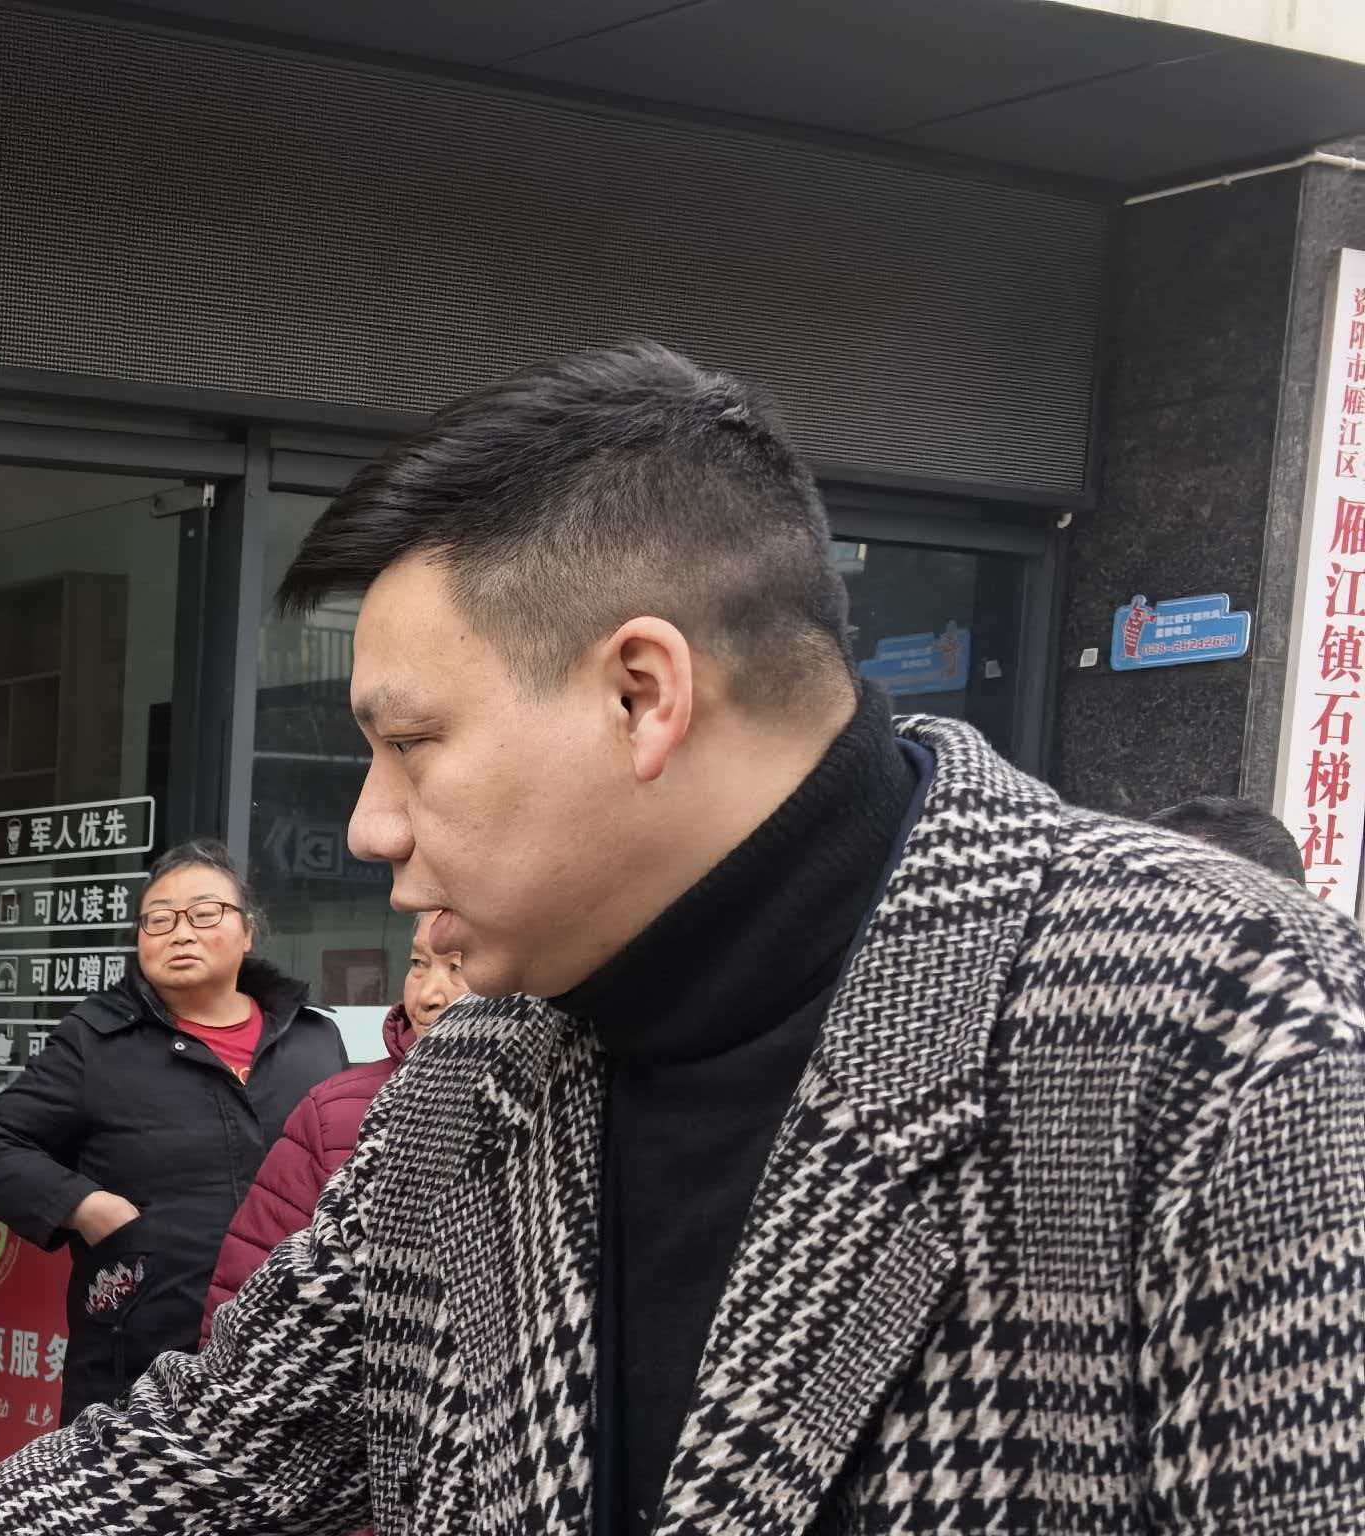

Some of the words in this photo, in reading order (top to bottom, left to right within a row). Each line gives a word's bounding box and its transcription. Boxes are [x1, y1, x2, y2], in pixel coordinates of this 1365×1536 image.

[29, 810, 127, 852] 军人优先
[32, 886, 129, 925] 可以读书
[30, 955, 126, 992] 可以蹭网
